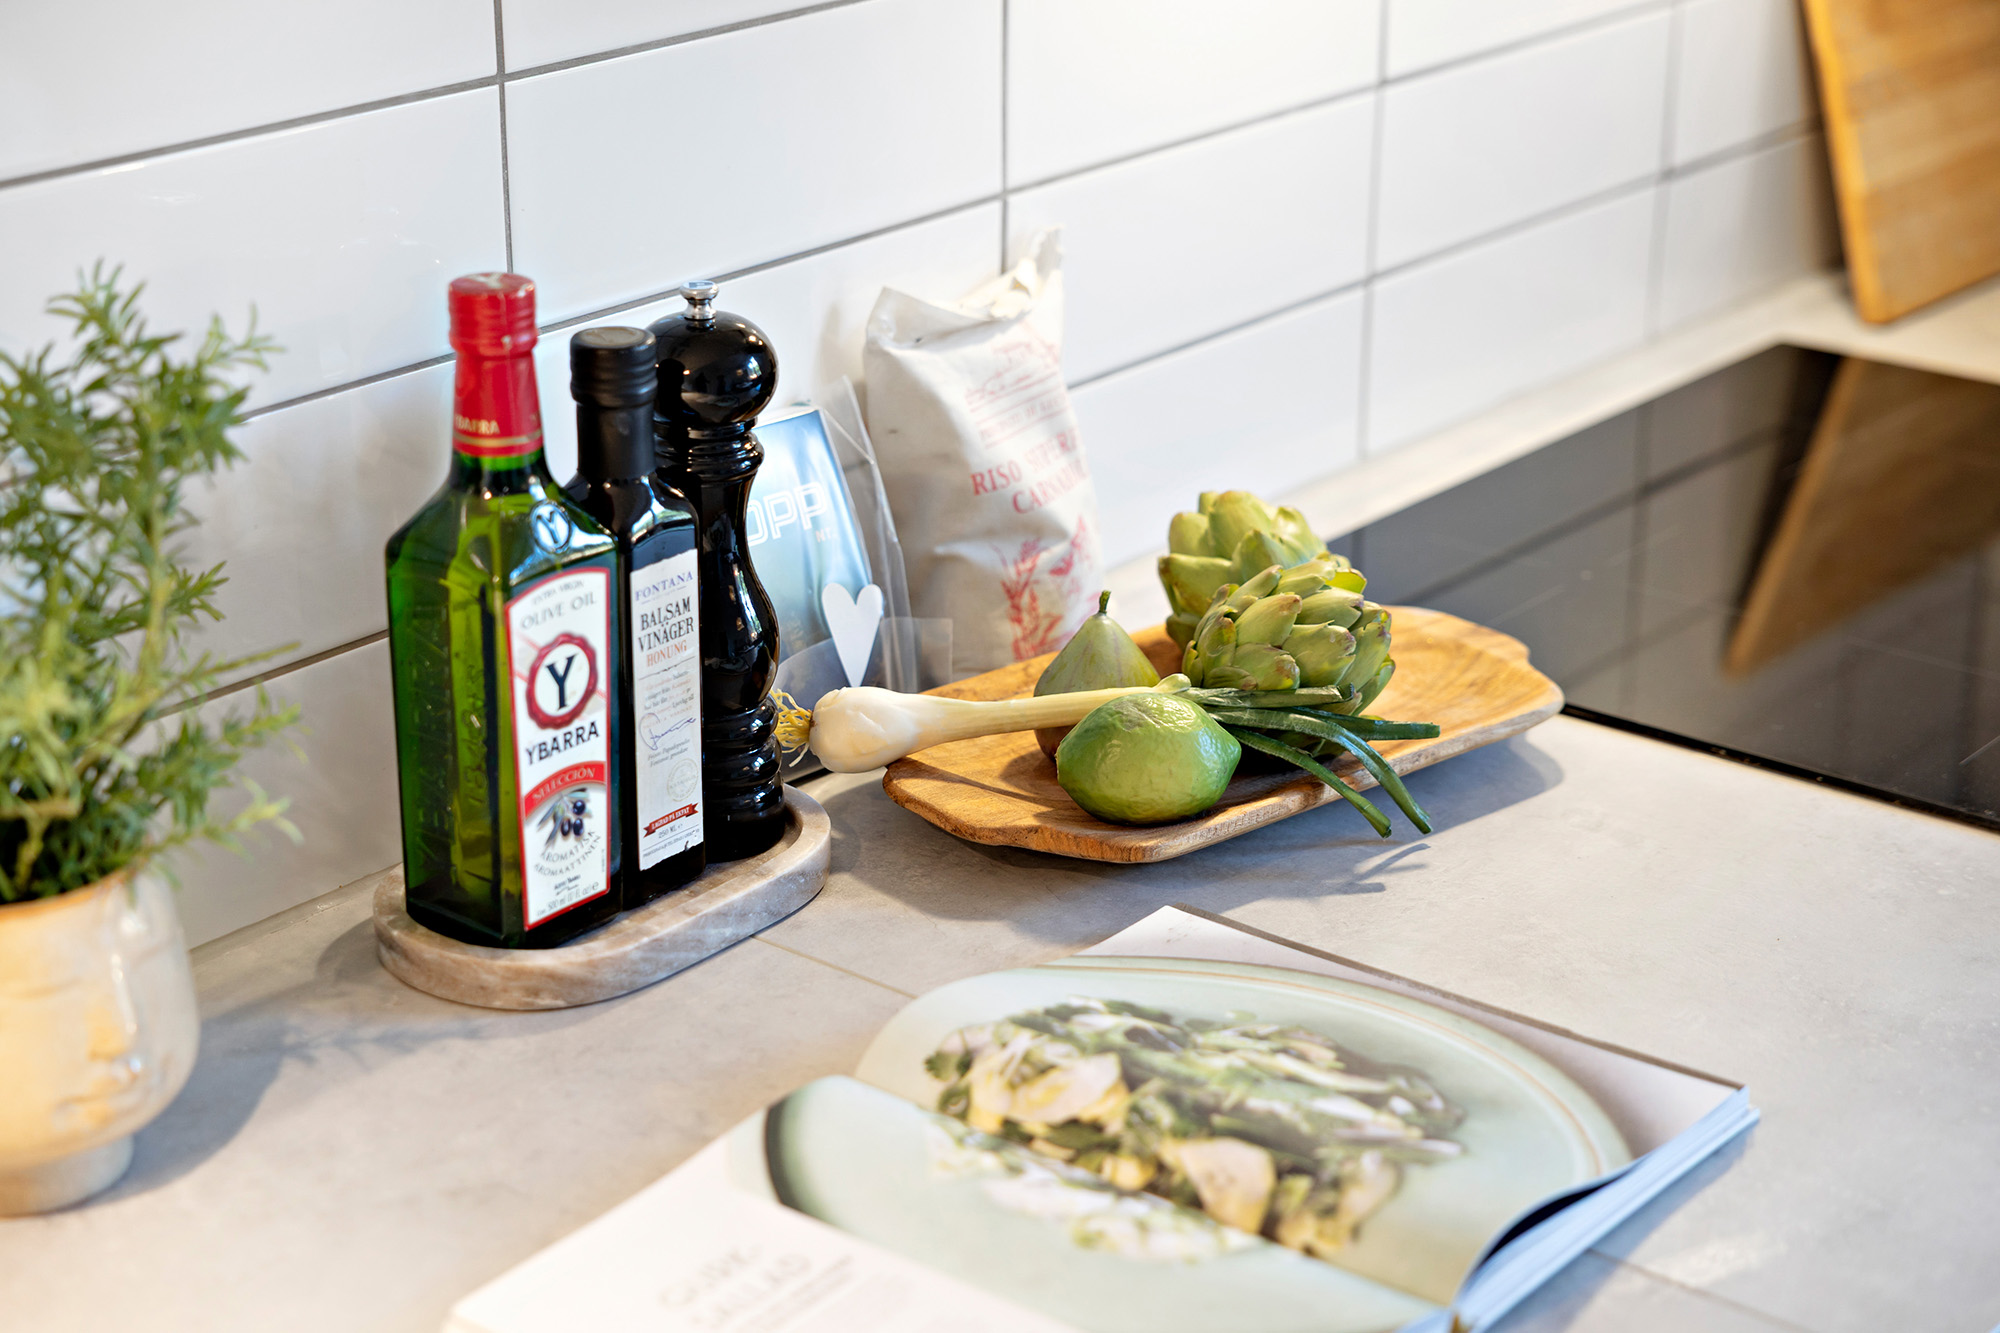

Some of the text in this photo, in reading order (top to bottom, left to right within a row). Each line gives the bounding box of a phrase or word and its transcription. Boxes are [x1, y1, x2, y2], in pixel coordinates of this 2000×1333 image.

[970, 460, 1022, 496] RISO
[635, 571, 694, 601] FONTANA
[520, 591, 598, 630] OLIVE OIL
[640, 596, 692, 632] BALSAM
[638, 616, 695, 652] VINÄGER
[645, 640, 688, 667] HONUNG
[546, 653, 578, 711] Y
[525, 721, 600, 765] YBARRA
[541, 829, 596, 863] AROMATISK
